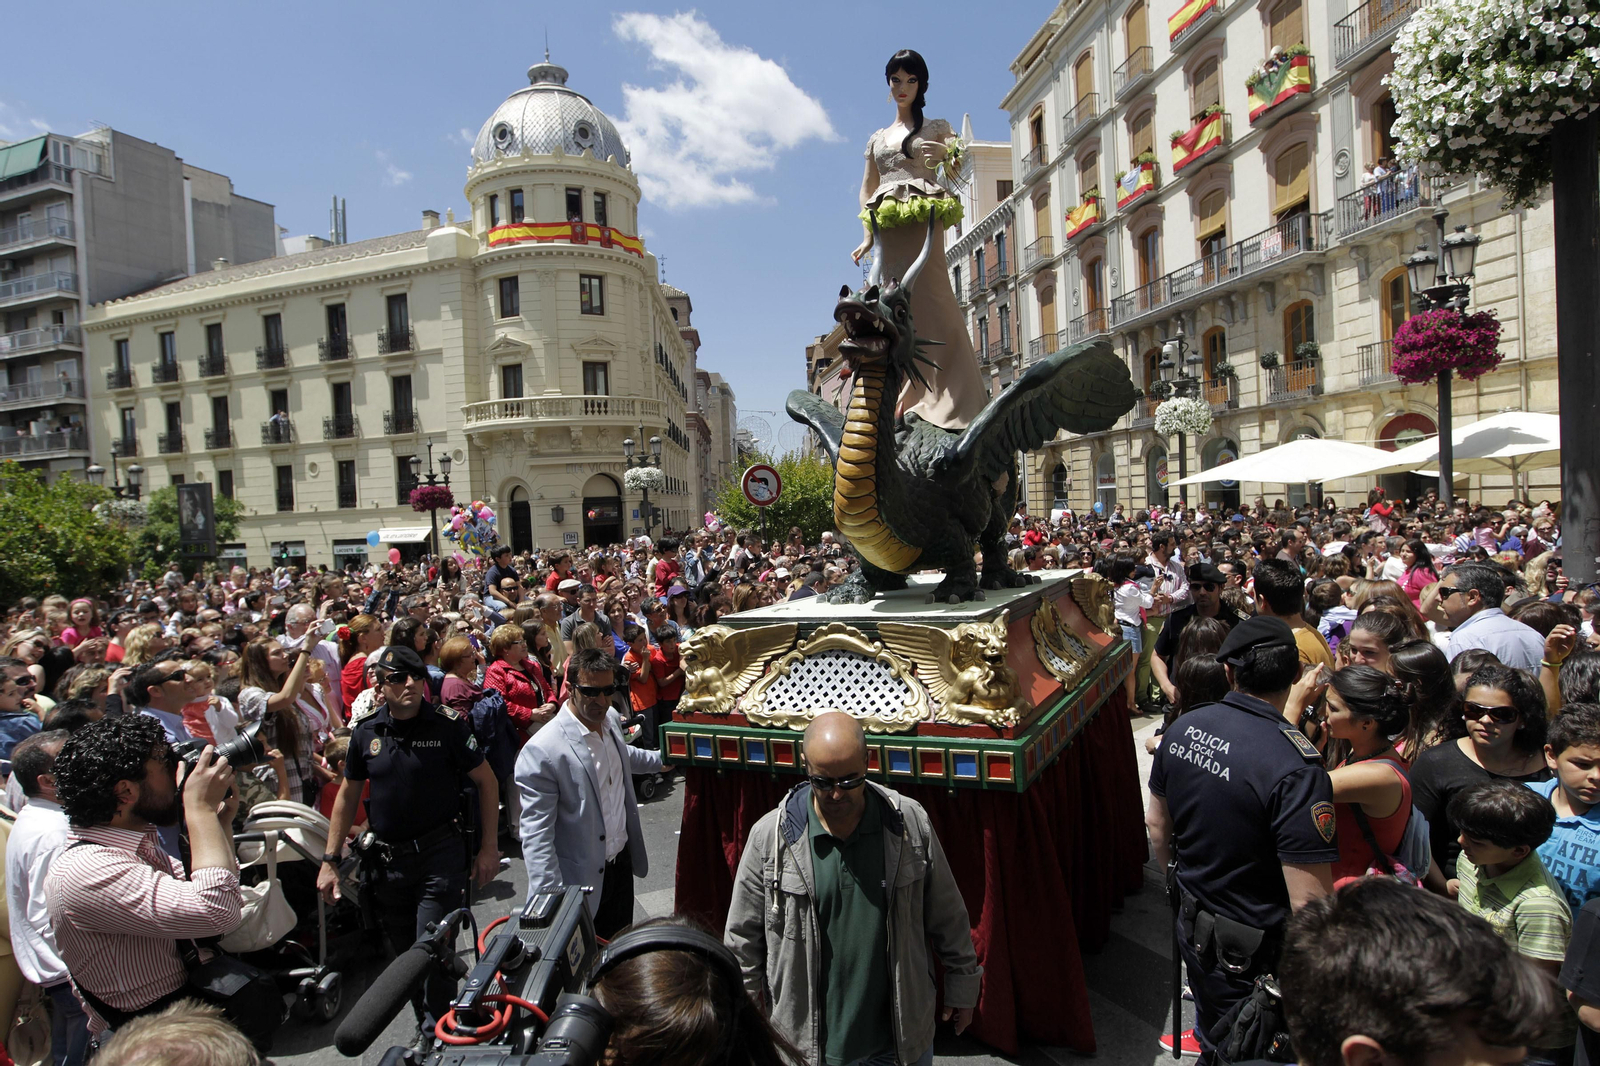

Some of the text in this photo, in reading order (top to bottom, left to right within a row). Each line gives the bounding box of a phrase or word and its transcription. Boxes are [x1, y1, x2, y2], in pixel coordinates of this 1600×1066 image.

[411, 740, 442, 748] POLICIA
[1184, 725, 1230, 755] POLICIA
[1189, 741, 1214, 758] LOCAL
[1169, 742, 1230, 782] GRANADA
[1574, 834, 1596, 845] TEAM
[1576, 828, 1598, 839] FIRST
[1557, 840, 1600, 868] ATH
